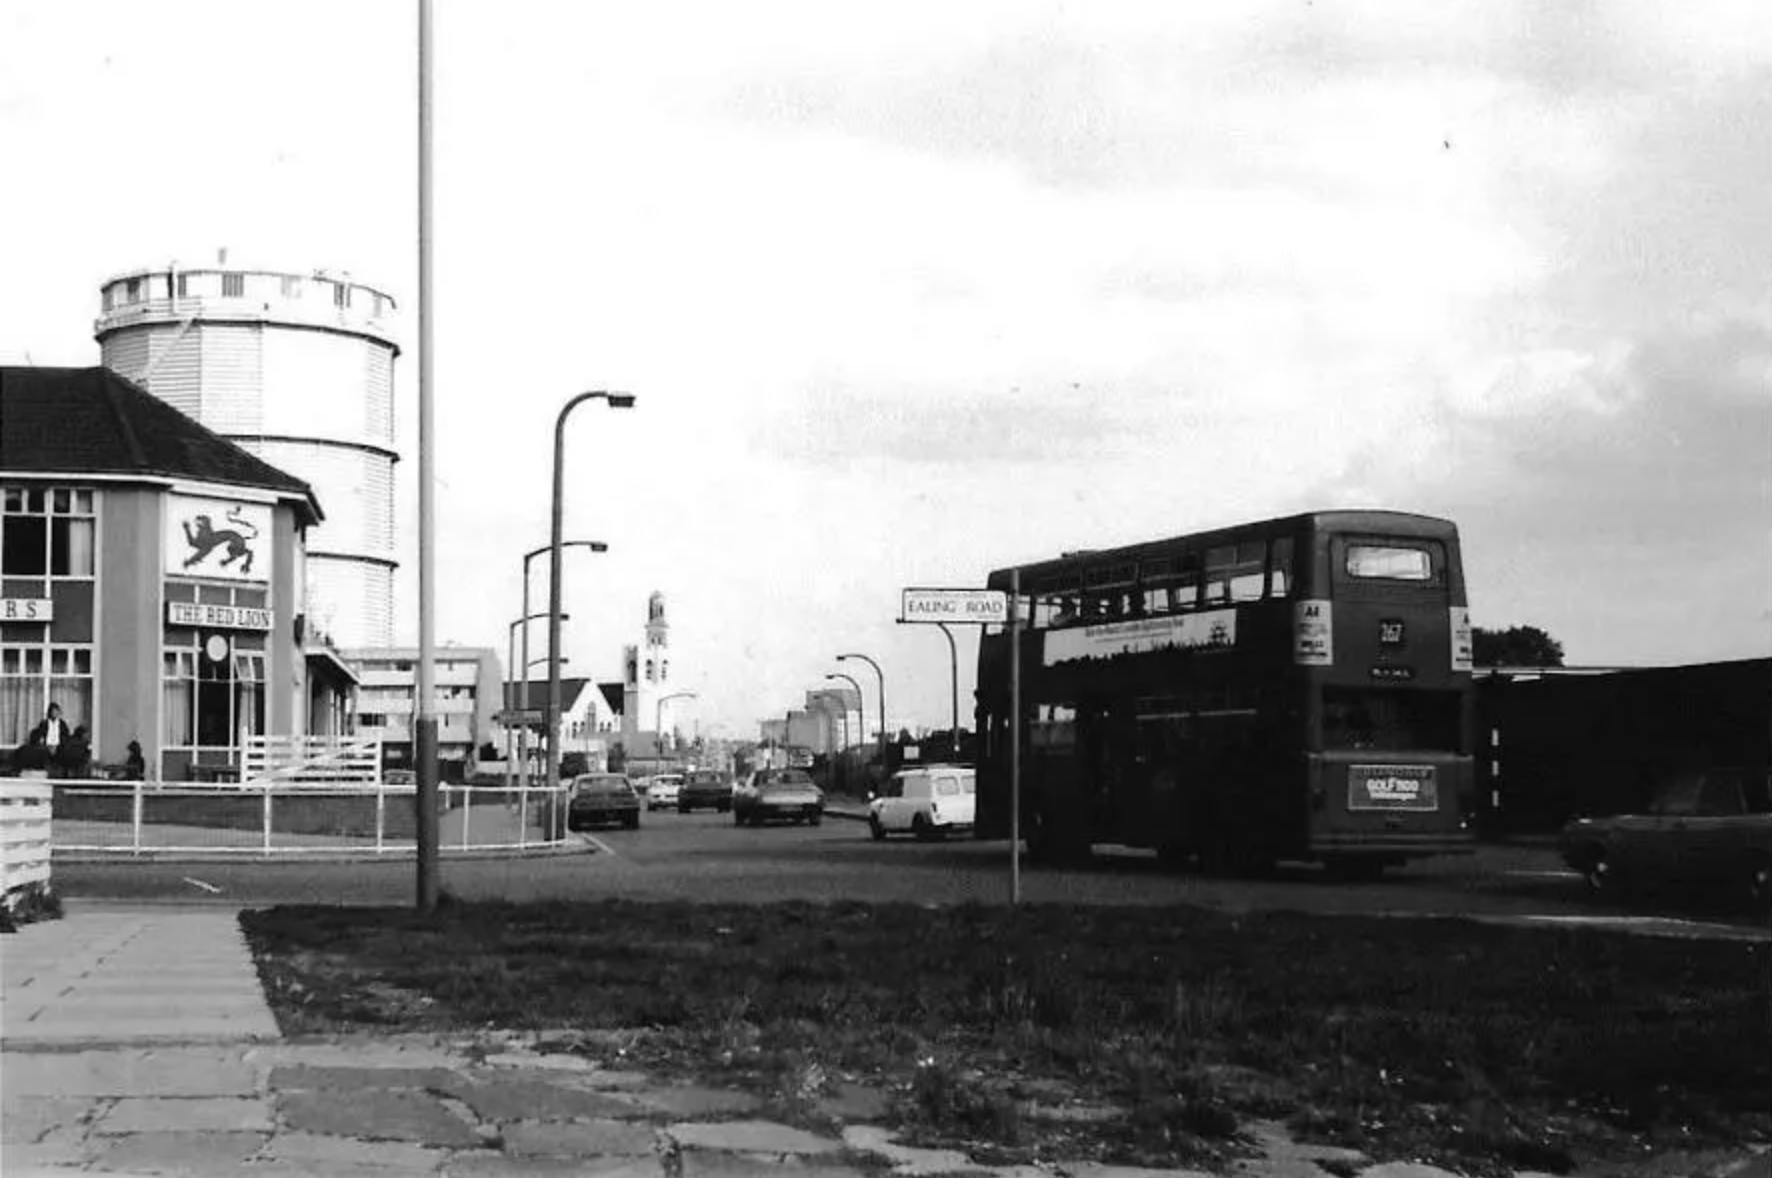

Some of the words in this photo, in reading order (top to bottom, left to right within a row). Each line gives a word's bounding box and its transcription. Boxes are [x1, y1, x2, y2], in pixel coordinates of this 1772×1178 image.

[908, 600, 957, 614] EALING
[966, 601, 1003, 614] ROAD
[173, 604, 203, 623] THE
[206, 606, 234, 625] RED
[238, 608, 271, 628] LION
[1366, 777, 1396, 792] GOLF
